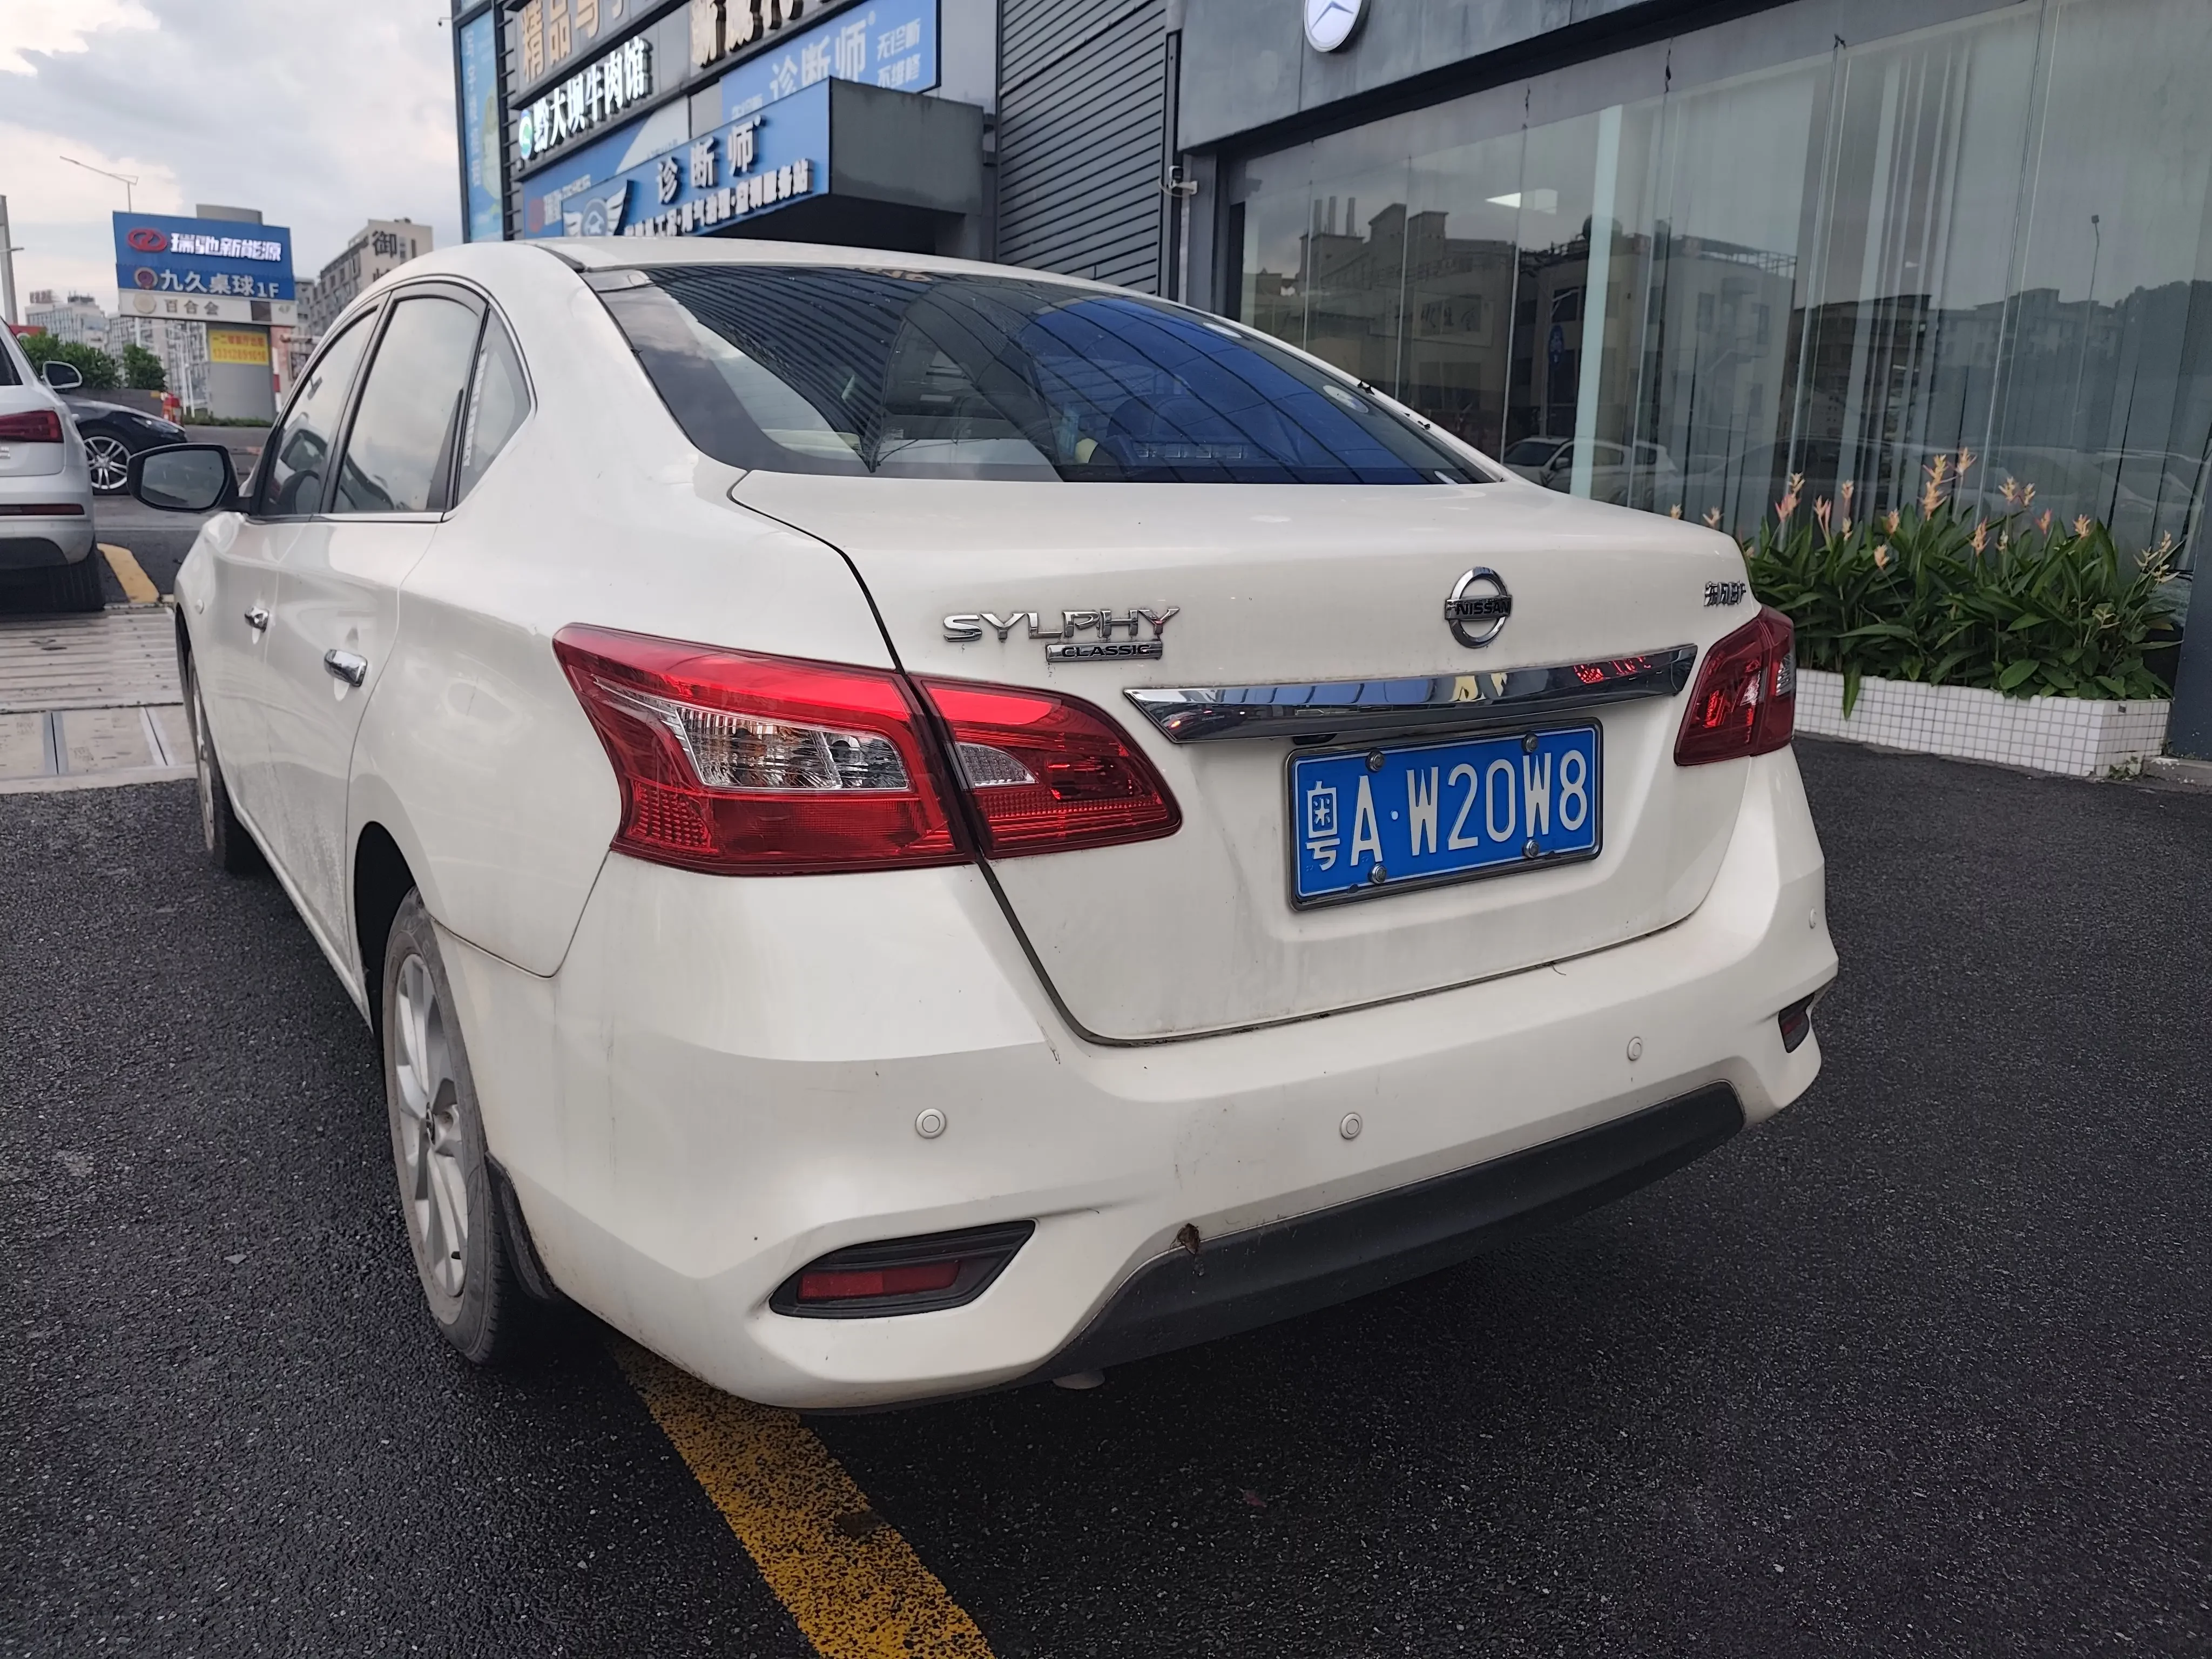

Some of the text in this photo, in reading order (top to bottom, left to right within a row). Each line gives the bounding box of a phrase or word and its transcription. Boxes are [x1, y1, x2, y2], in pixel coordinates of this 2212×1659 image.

[769, 18, 867, 100] 诊断师
[877, 53, 921, 89] 不维修
[657, 120, 754, 204] 诊断师
[170, 232, 281, 262] 瑞驰新能源
[160, 269, 279, 298] 九久桌球 1F
[943, 606, 1181, 642] SYLPHY
[1456, 601, 1510, 616] NISSAN
[1061, 644, 1151, 658] CLASSIC
